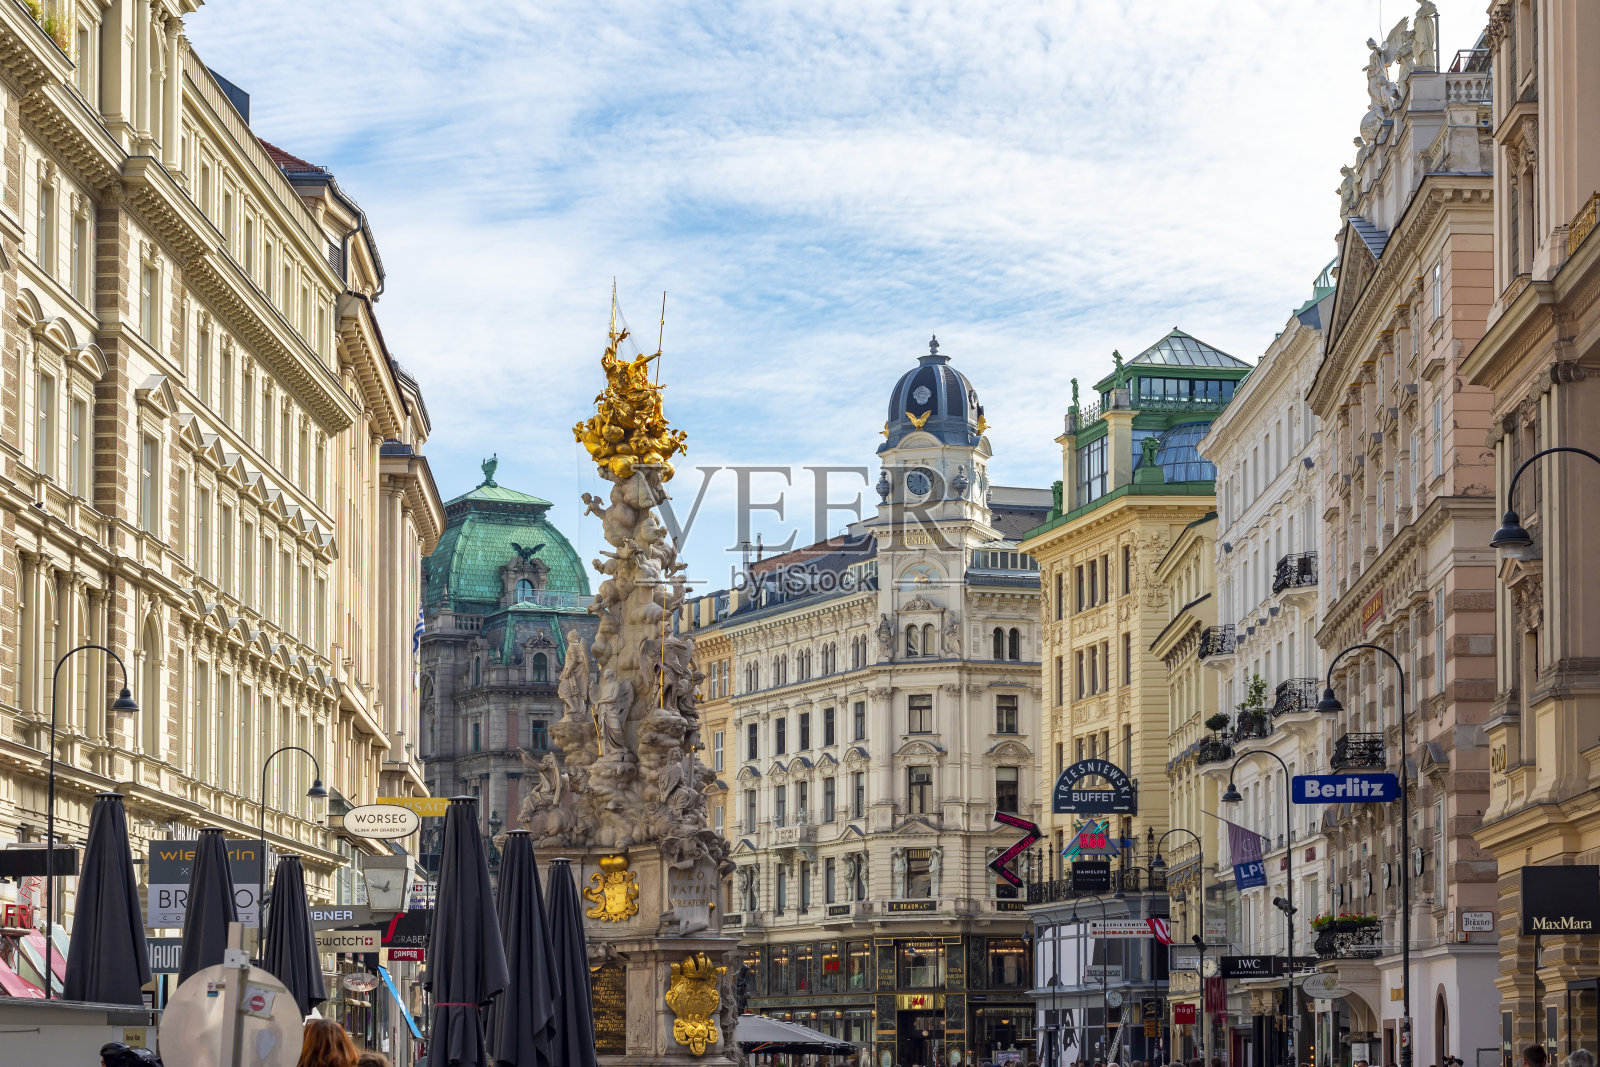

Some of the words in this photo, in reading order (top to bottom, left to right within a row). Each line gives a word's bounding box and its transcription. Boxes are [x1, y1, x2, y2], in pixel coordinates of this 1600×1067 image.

[1059, 762, 1130, 800] TRZESNIEWSKI
[1304, 778, 1384, 798] Berlitz
[1072, 793, 1116, 802] BUFFET
[355, 814, 407, 824] WORSEG
[1532, 917, 1592, 929] MaxMara
[316, 936, 364, 946] swatch
[394, 950, 418, 959] CAMPER
[1238, 960, 1261, 969] IWC
